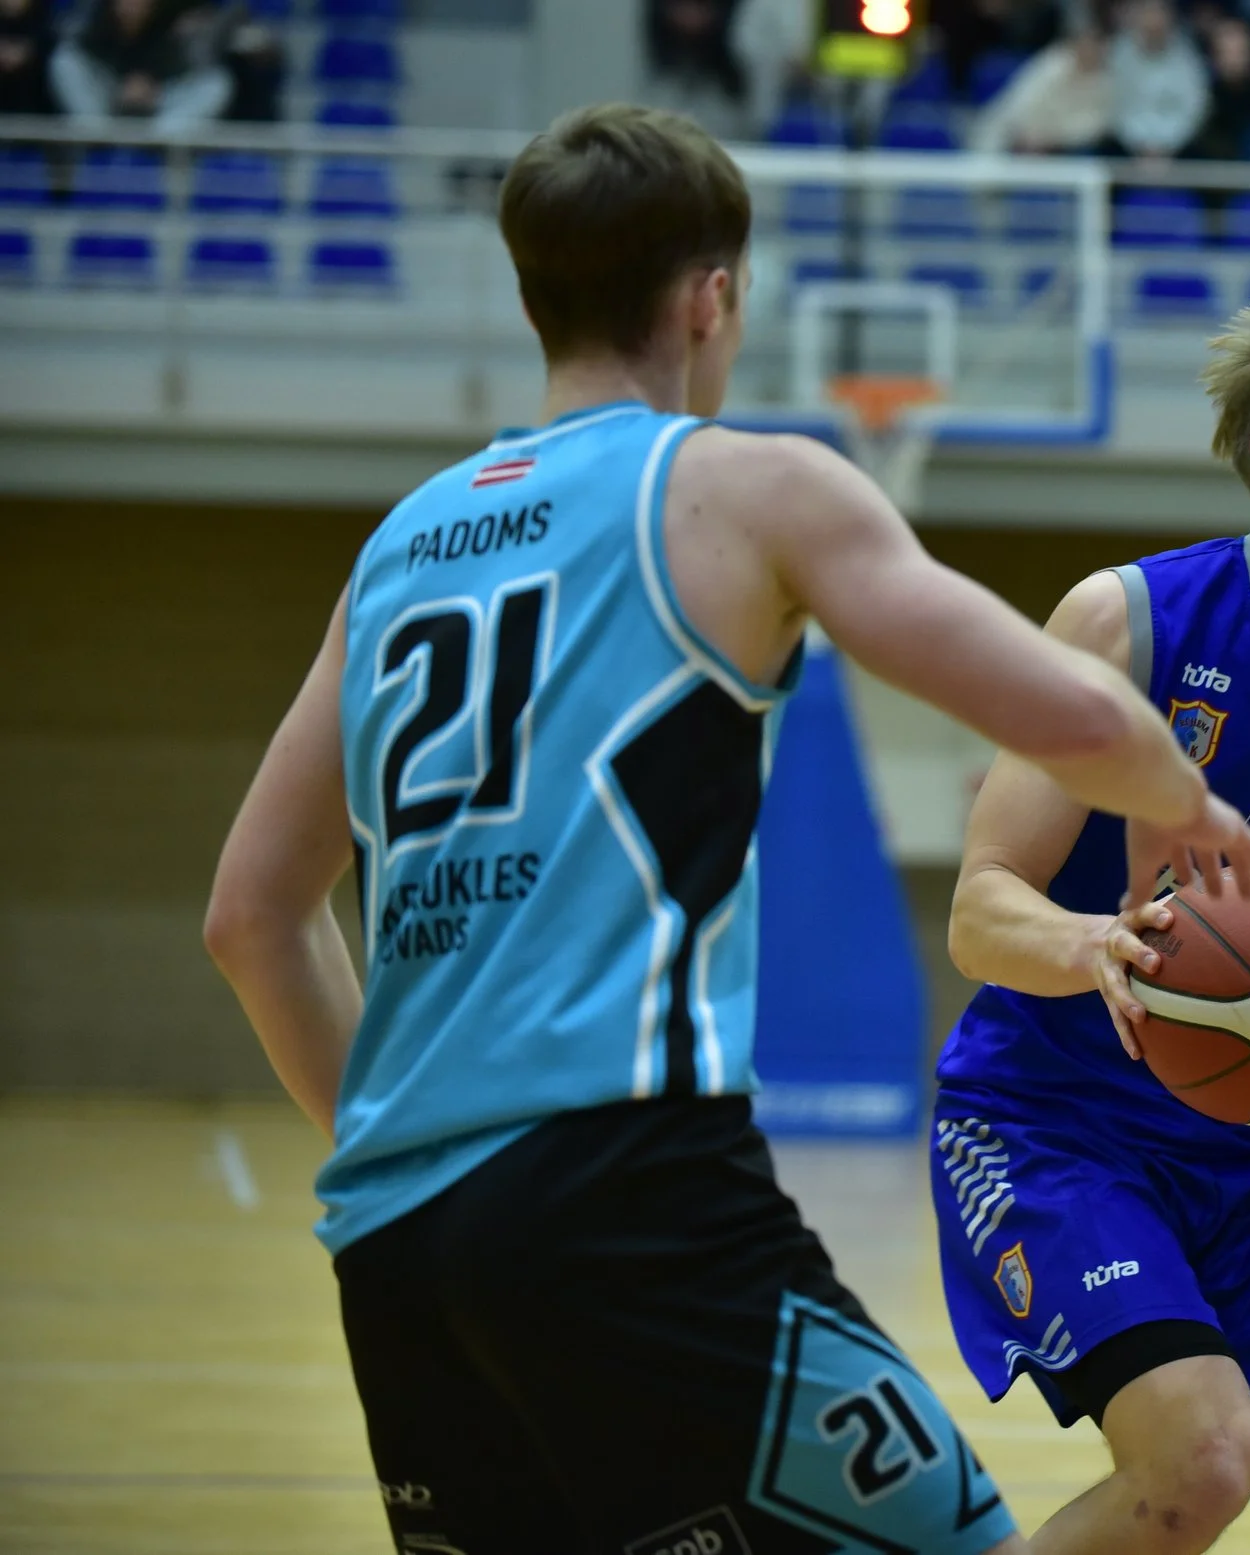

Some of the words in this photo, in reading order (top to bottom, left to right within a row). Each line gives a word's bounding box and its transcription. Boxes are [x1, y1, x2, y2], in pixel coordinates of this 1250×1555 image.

[406, 500, 553, 572] PADOMS
[373, 571, 559, 867] 21
[816, 1367, 948, 1507] 21
